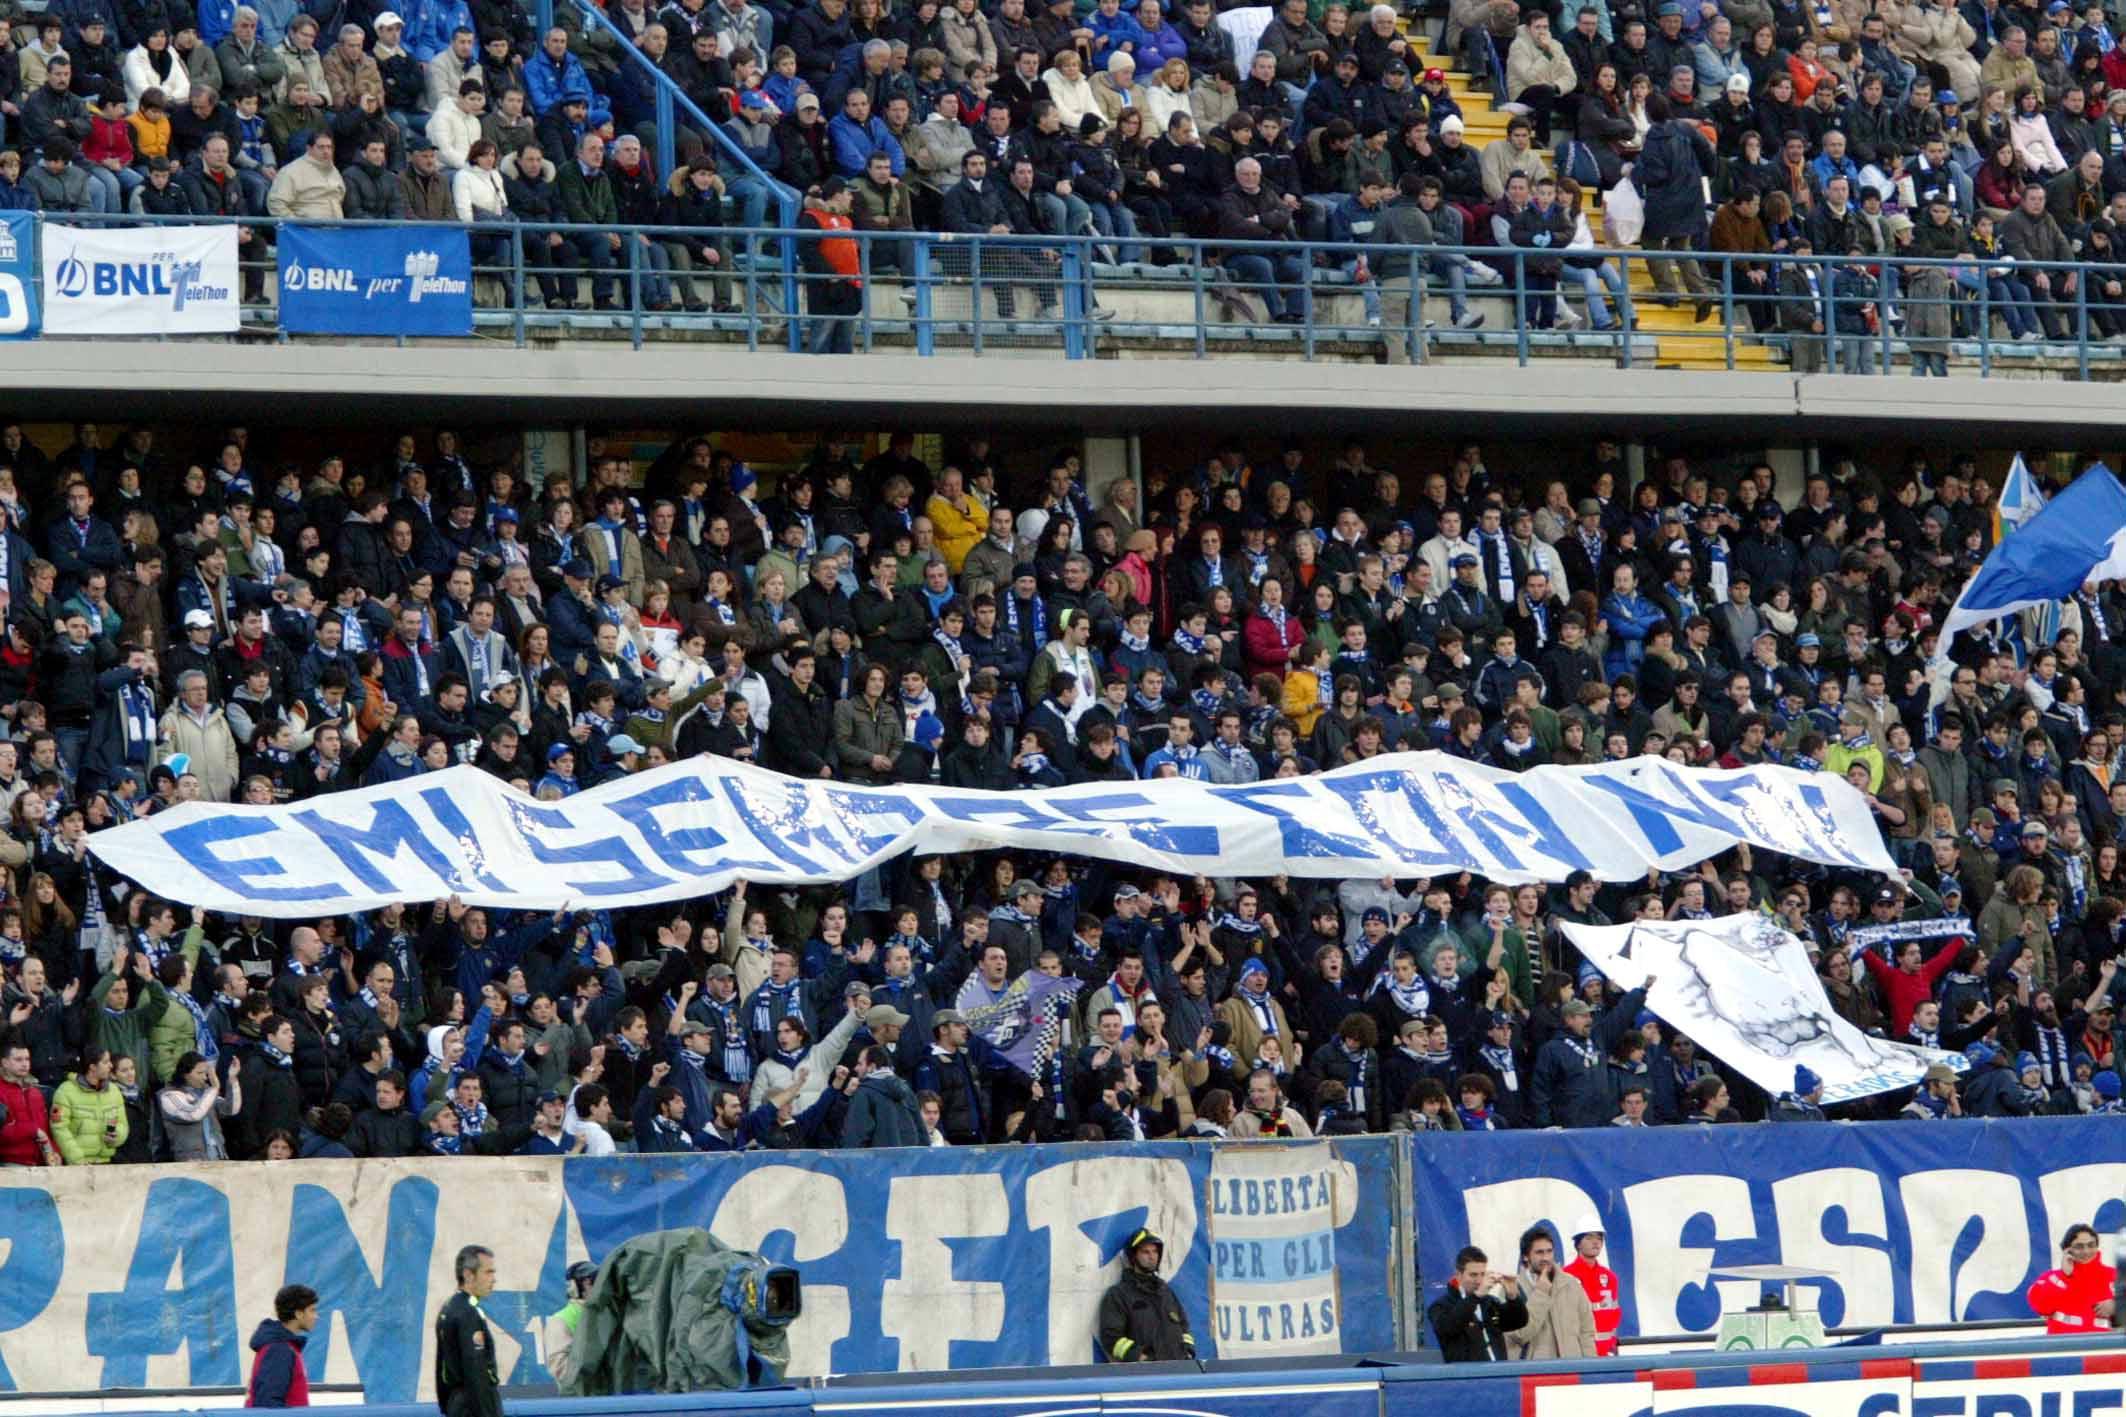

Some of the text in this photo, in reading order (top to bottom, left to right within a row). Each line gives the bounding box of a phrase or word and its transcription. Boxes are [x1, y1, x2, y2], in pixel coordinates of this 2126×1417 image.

[152, 252, 174, 262] PER
[94, 262, 171, 297] BNL
[307, 268, 359, 292] BNL
[365, 276, 403, 301] per
[706, 1155, 1358, 1378] GER
[1215, 1233, 1334, 1278] PER GLI
[1216, 1298, 1335, 1341] ULTRAS
